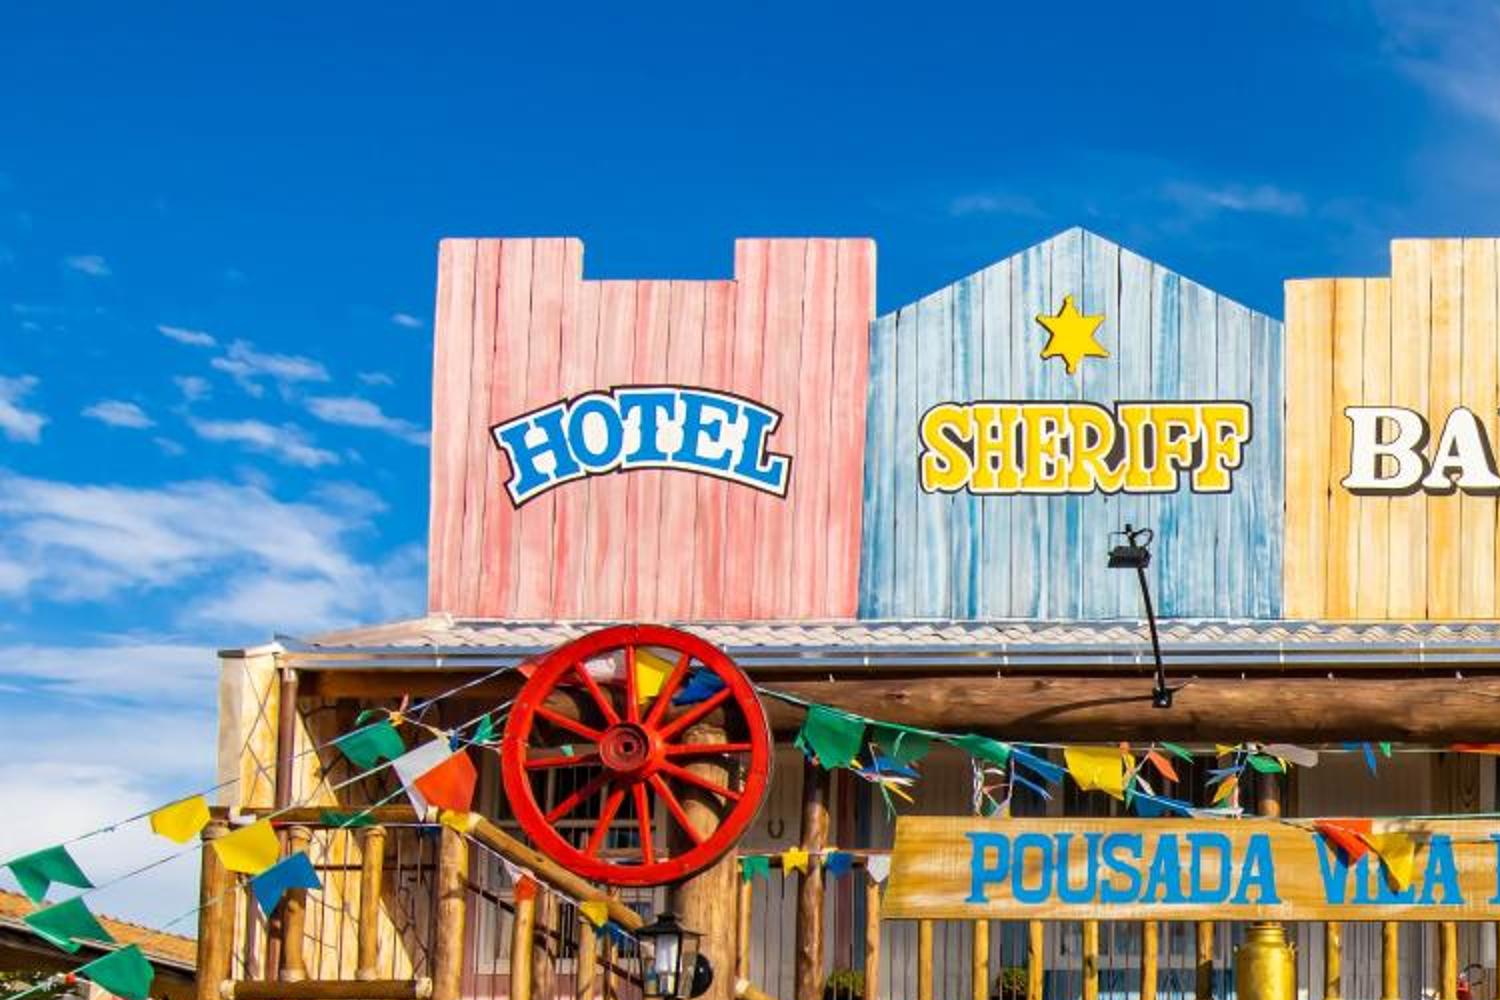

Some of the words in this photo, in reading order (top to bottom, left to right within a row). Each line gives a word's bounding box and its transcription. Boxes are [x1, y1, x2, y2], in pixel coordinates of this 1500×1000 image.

[491, 386, 791, 506] HOTEL
[921, 402, 1251, 494] SHERIFF
[964, 832, 1282, 904] POUSADA
